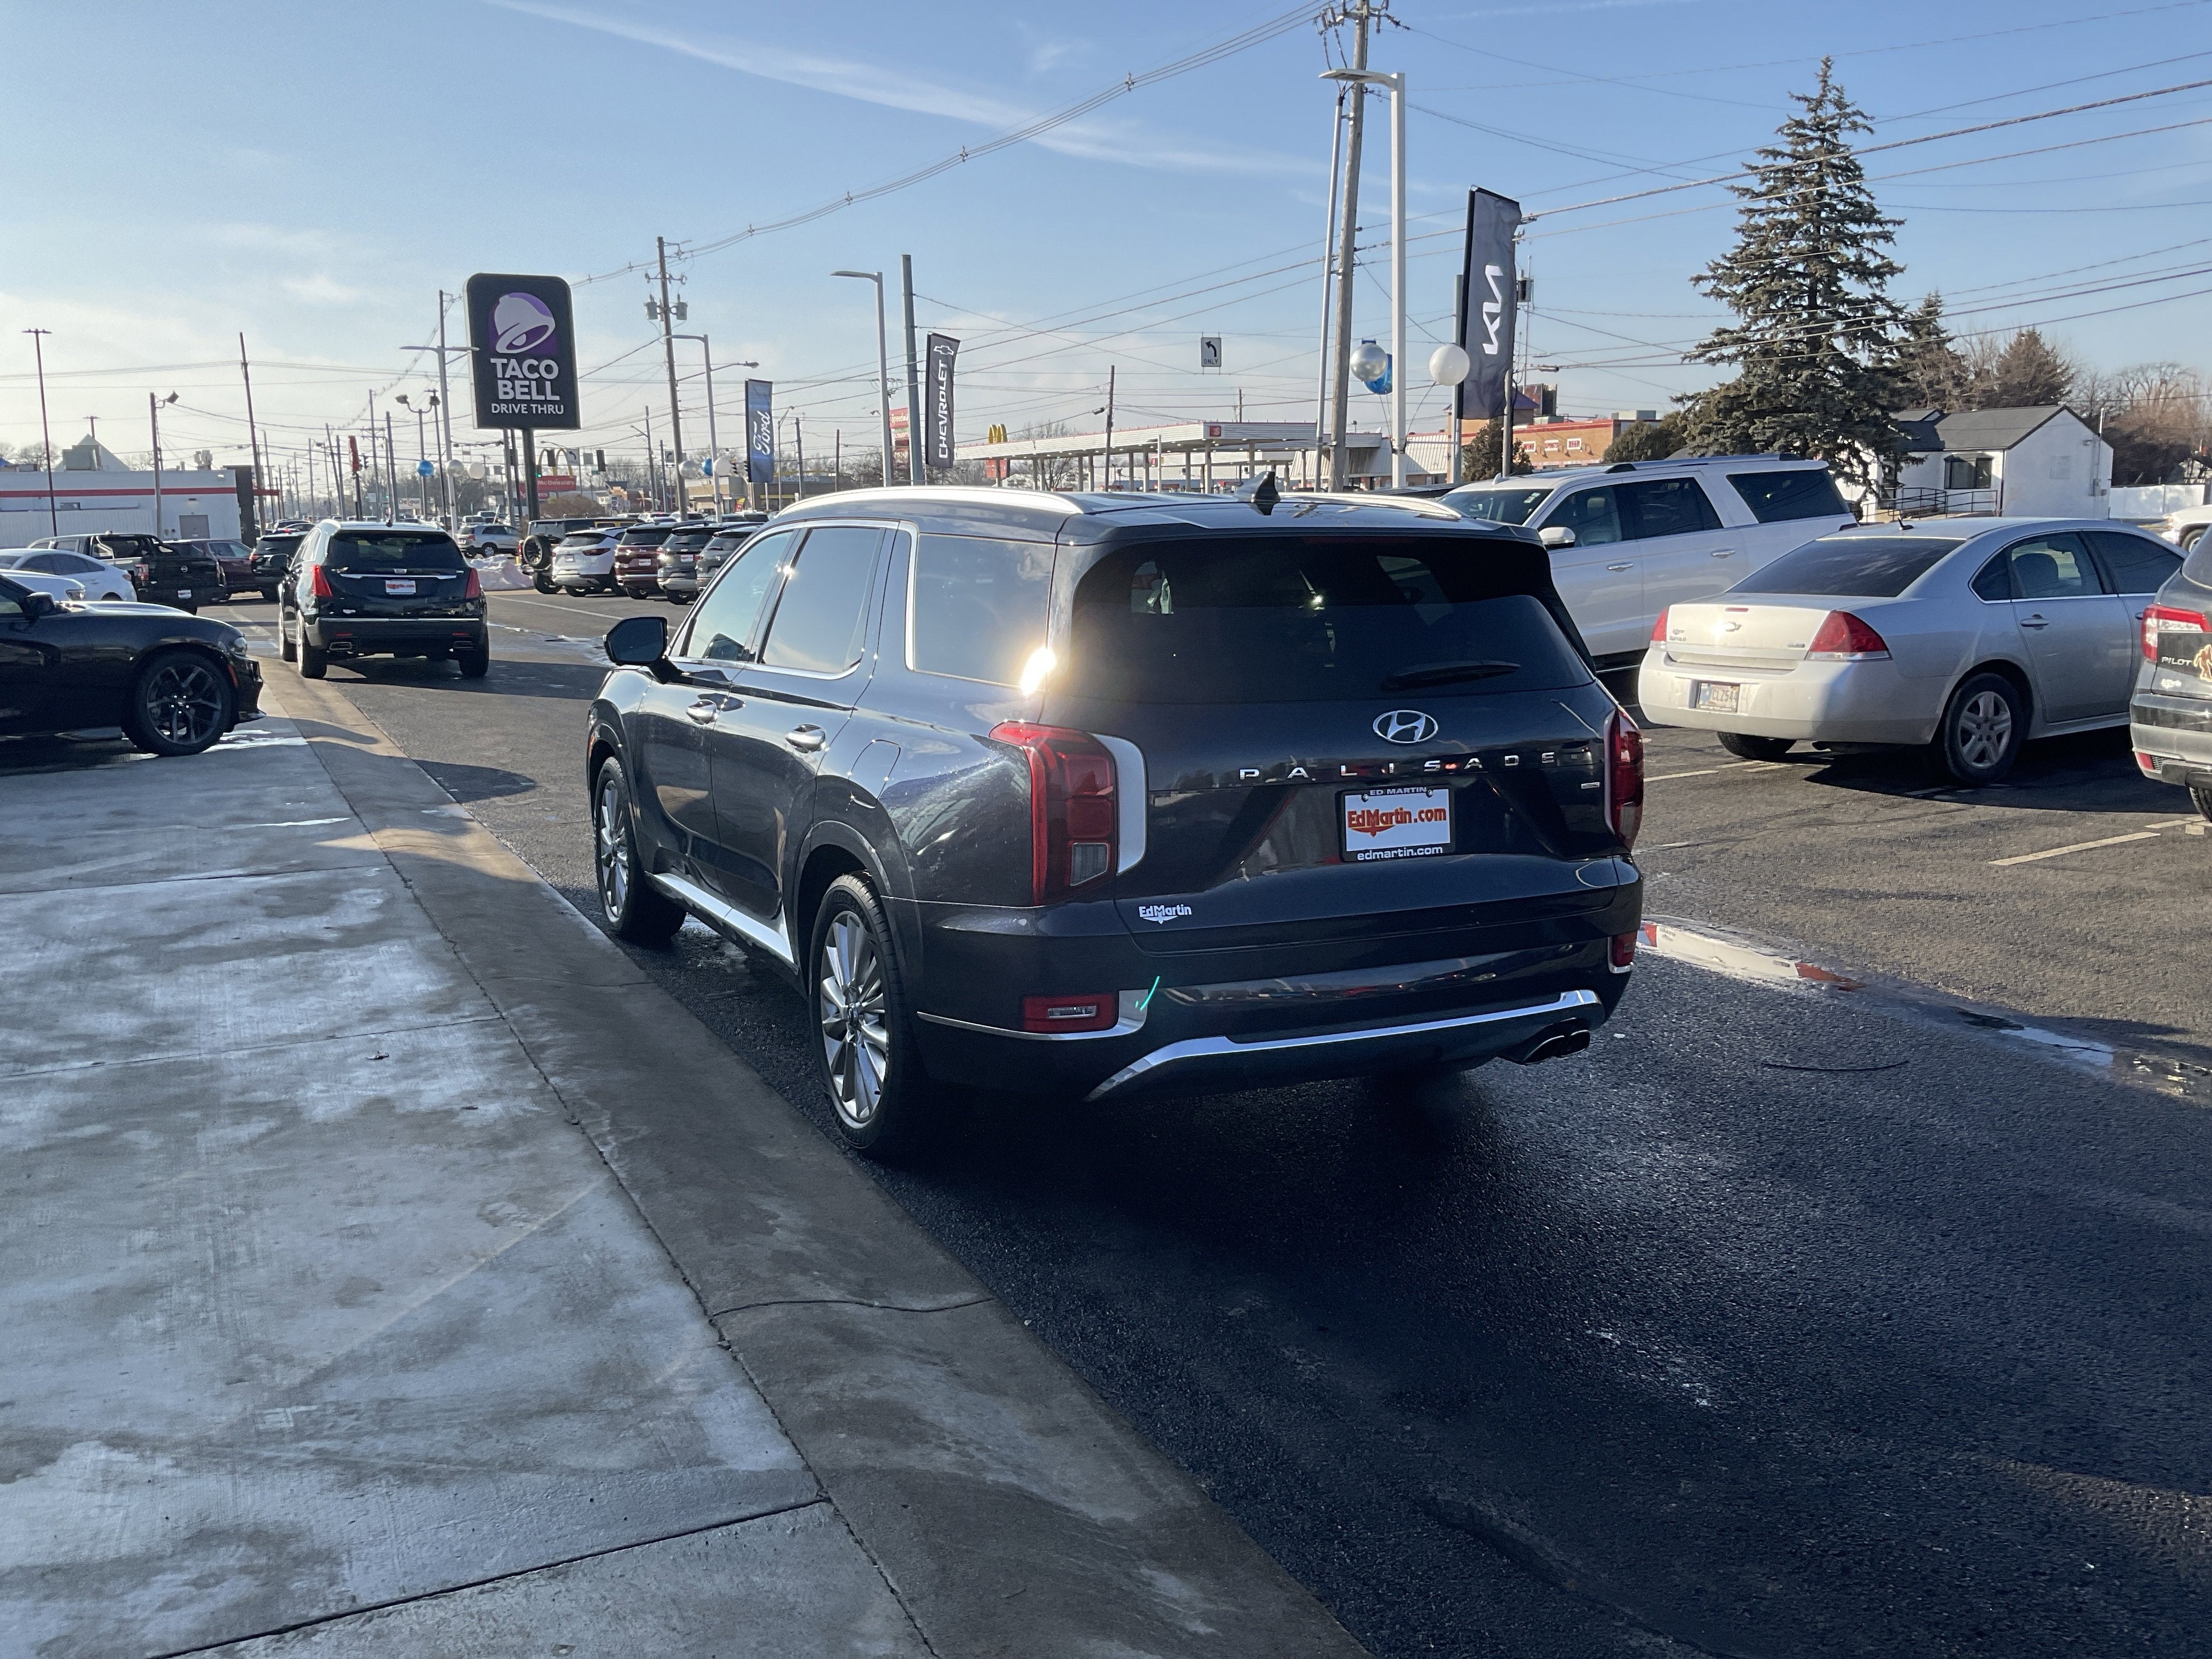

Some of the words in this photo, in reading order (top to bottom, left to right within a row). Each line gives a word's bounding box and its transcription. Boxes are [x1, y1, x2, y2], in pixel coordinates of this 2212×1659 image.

[490, 358, 558, 380] TACO
[498, 380, 560, 401] BELL
[491, 403, 528, 414] DRIVE
[531, 404, 563, 415] THRU
[938, 360, 948, 458] CHEVROLET
[754, 410, 770, 455] Ford
[2162, 657, 2192, 666] PILOT
[1240, 752, 1555, 780] PALISADE
[1357, 846, 1443, 861] edmartin.com
